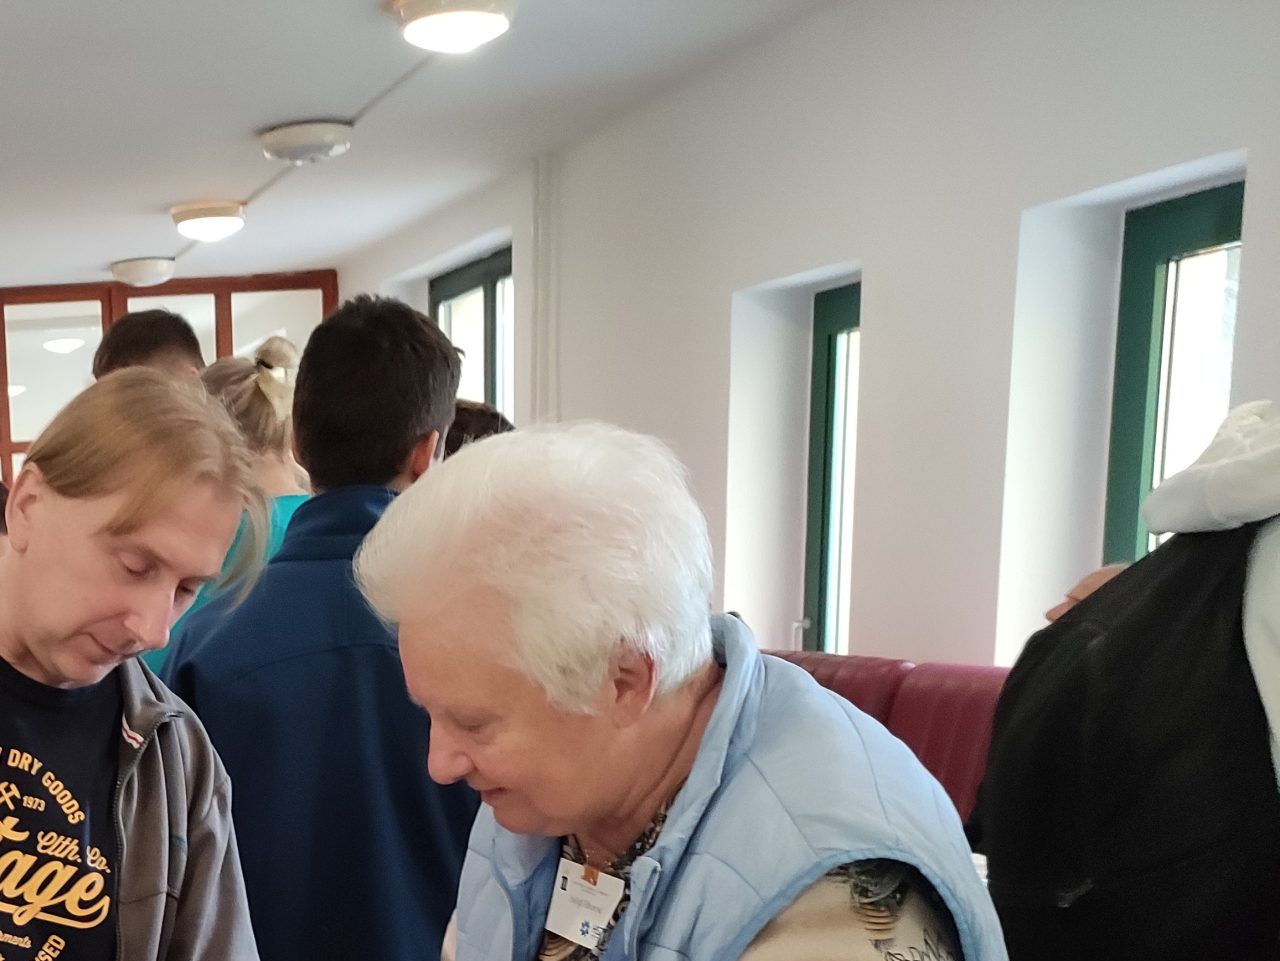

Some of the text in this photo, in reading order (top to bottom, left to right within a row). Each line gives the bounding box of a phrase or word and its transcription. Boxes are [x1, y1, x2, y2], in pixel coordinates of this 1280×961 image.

[6, 748, 44, 776] DRY
[40, 770, 86, 825] GOODS
[22, 794, 47, 812] 1973
